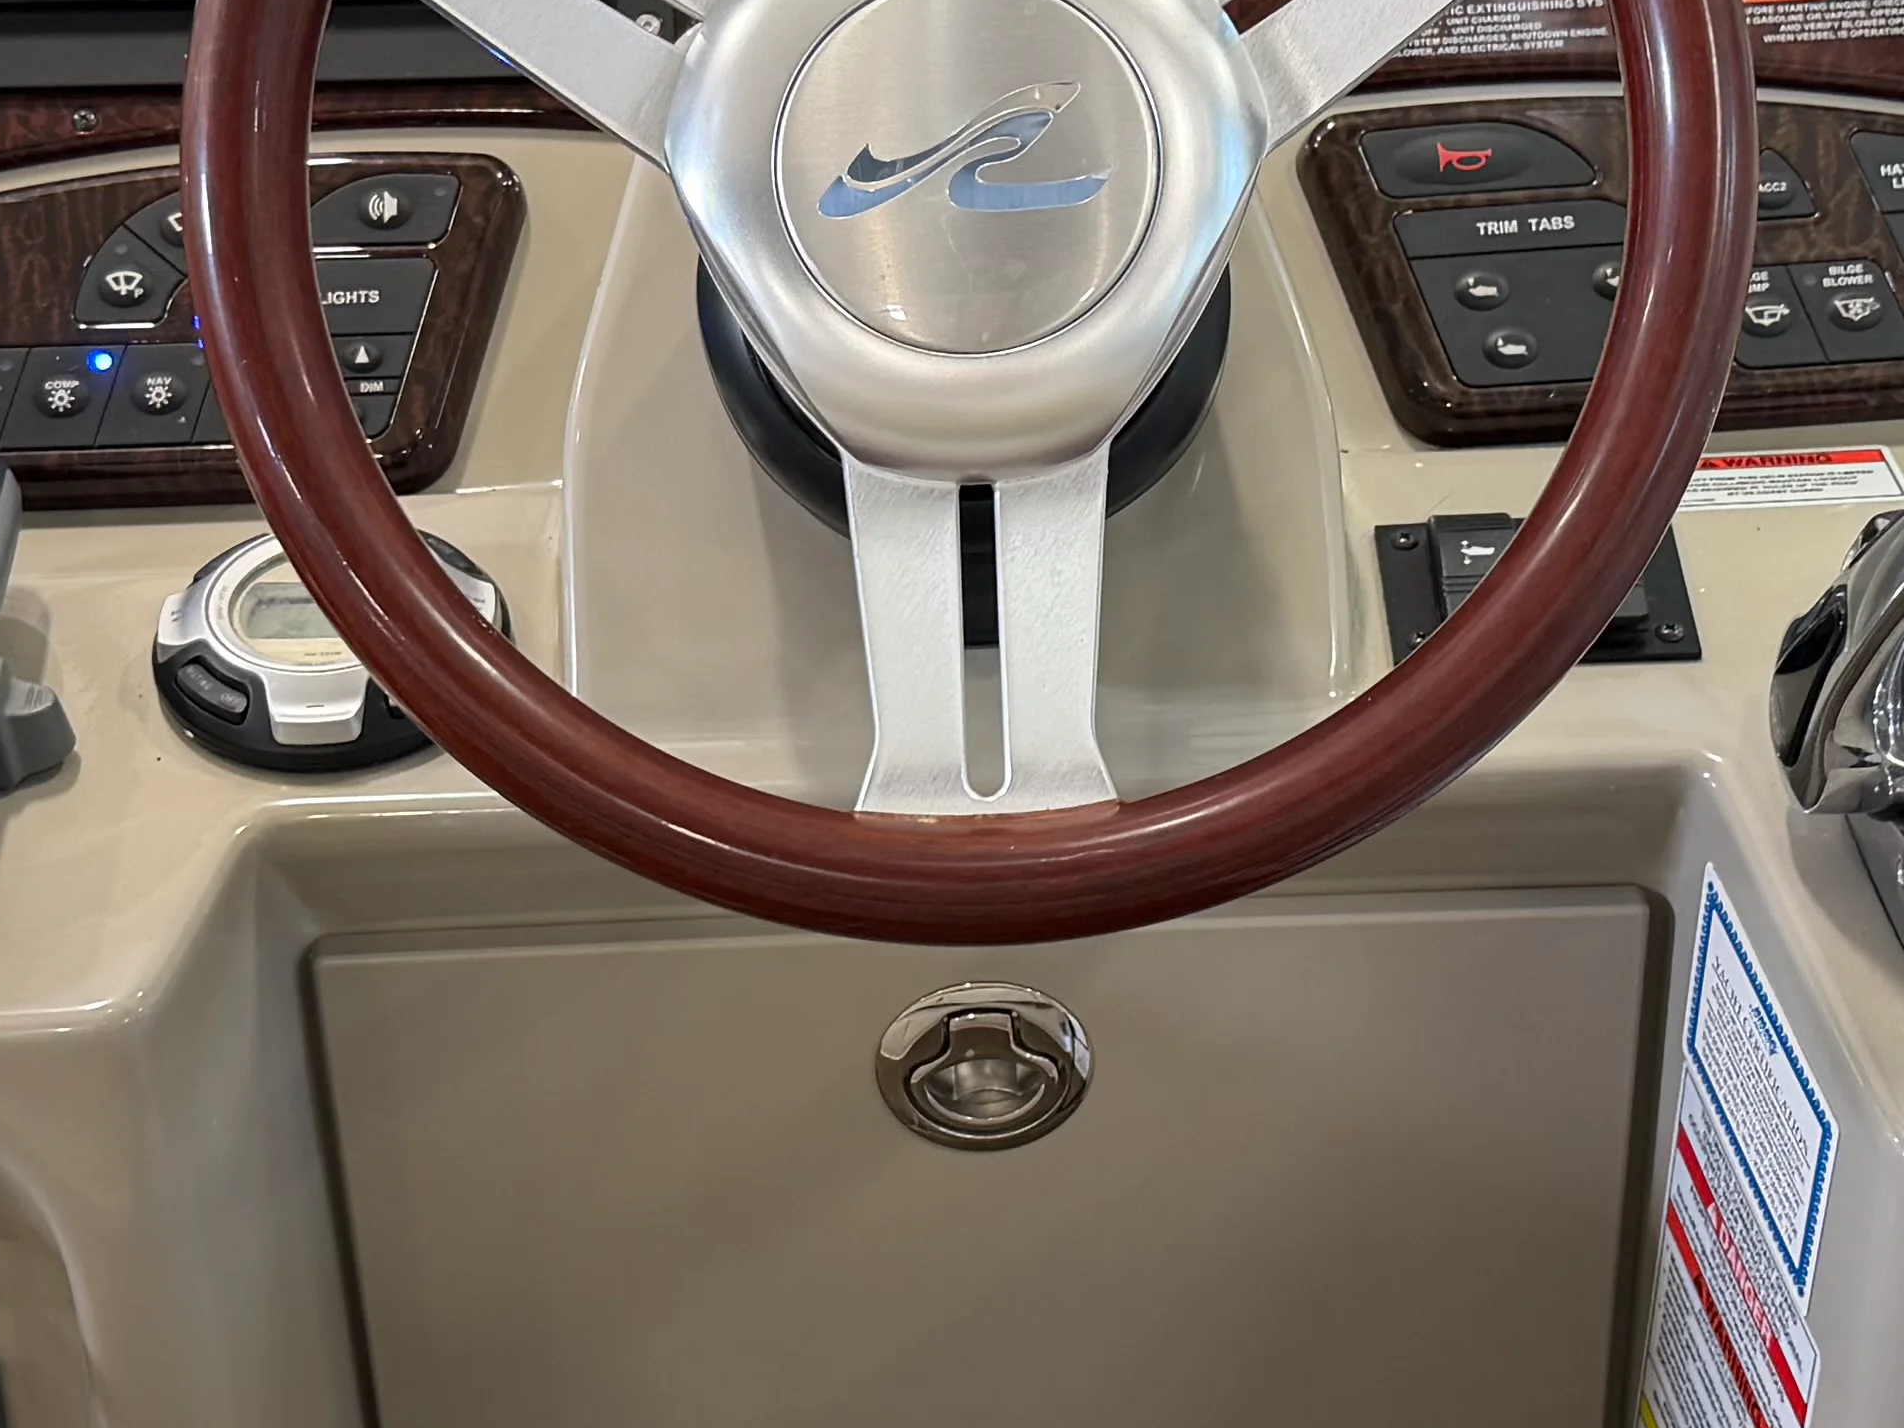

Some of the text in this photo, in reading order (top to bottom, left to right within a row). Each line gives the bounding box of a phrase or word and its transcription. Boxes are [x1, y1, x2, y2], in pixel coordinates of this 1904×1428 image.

[1476, 215, 1575, 236] TRIM TABS
[1828, 264, 1864, 276] BILGE
[1822, 273, 1873, 288] BLOWER
[134, 288, 144, 299] P
[44, 379, 80, 391] COMP
[146, 377, 173, 386] NAV
[360, 381, 384, 393] DIM
[1720, 453, 1834, 468] WARNING
[1718, 1219, 1772, 1353] DANGER
